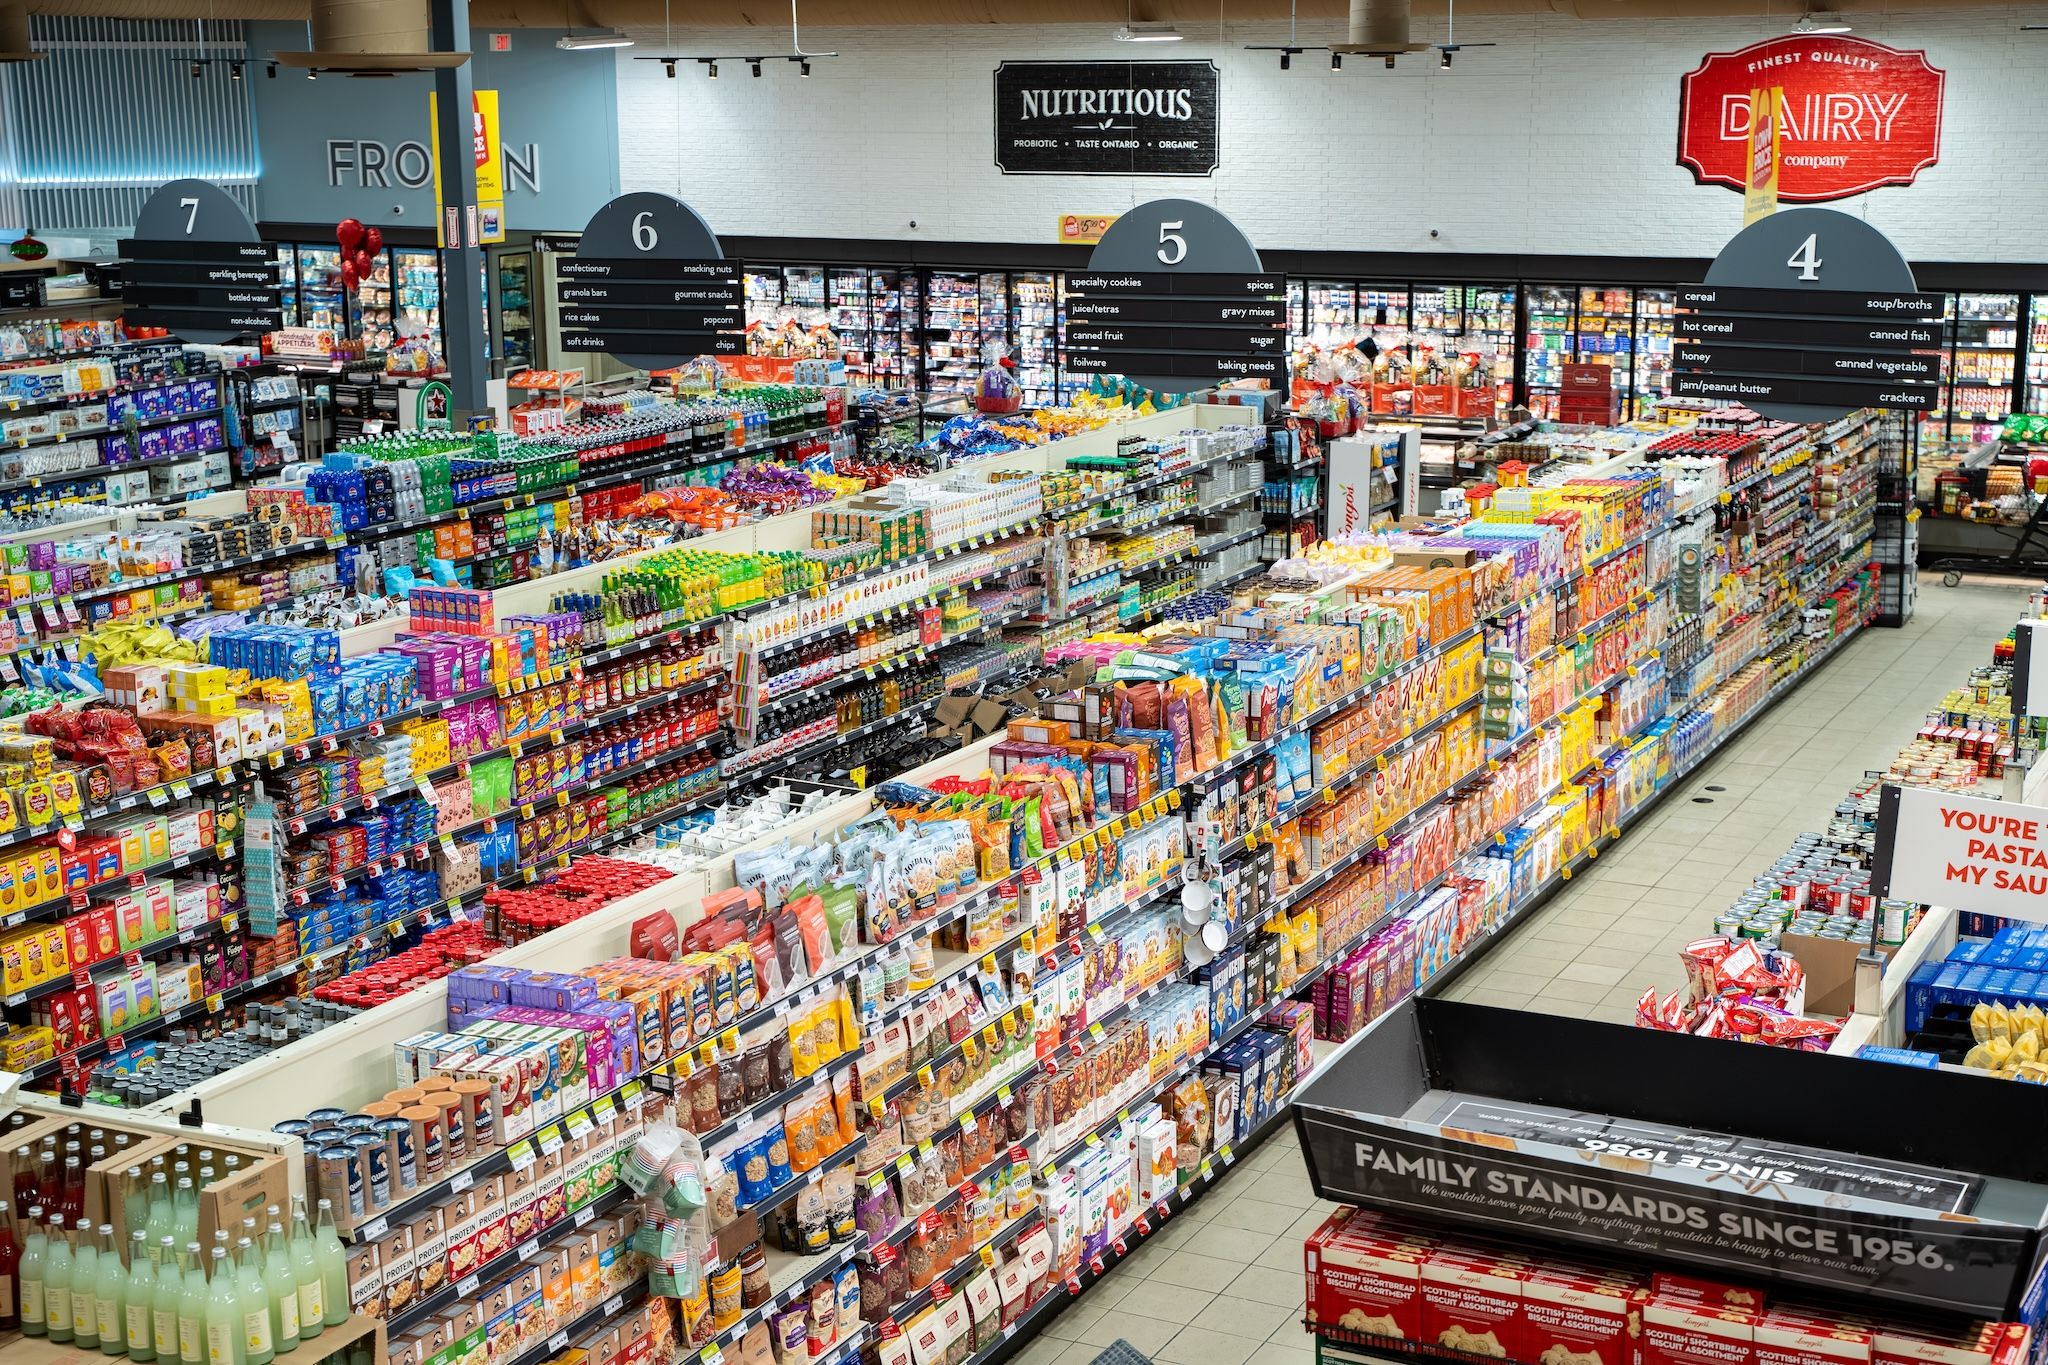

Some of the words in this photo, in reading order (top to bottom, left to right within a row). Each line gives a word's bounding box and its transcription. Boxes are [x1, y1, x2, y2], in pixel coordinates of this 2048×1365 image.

[1748, 52, 1802, 74] FINEST
[1811, 51, 1880, 72] QUALITY
[1020, 88, 1192, 121] NUTRITIOUS
[1720, 93, 1908, 142] DAIRY
[1014, 139, 1058, 148] PROBIOTIC
[1075, 140, 1100, 148] TASTE
[1102, 140, 1140, 149] ONTARIO
[1159, 140, 1199, 149] ORGANIC
[327, 139, 540, 193] FRON
[1784, 154, 1848, 169] company
[180, 198, 199, 234] 7
[632, 211, 658, 251] 6
[1157, 220, 1187, 265] 5
[240, 247, 266, 256] isotonics
[1787, 233, 1823, 281] 4
[209, 270, 236, 281] sparkling
[237, 270, 268, 281] beverages
[562, 264, 611, 275] confectionary
[683, 264, 715, 276] snacking
[717, 265, 733, 273] nuts
[1071, 277, 1108, 288] specialty
[1110, 277, 1142, 287] cookies
[1247, 280, 1274, 291] spices
[228, 293, 250, 302] bottled
[252, 294, 269, 302] water
[564, 289, 590, 299] granola
[591, 289, 607, 297] bars
[675, 291, 706, 301] gourmet
[708, 291, 733, 299] snacks
[1684, 291, 1716, 302] cereal
[1072, 303, 1120, 315] juice/tetras
[1867, 299, 1932, 311] soup/broths
[580, 314, 600, 322] cakes
[1222, 307, 1247, 319] gravy
[1249, 306, 1275, 316] mixes
[231, 317, 272, 326] non-alcoholic
[703, 317, 734, 326] popcorn
[1682, 321, 1700, 331] hot
[1702, 322, 1733, 333] cereal
[1072, 331, 1103, 341] canned
[1104, 331, 1124, 341] fruit
[1250, 336, 1275, 347] sugar
[1869, 330, 1908, 340] canned
[1910, 331, 1931, 341] fish
[277, 339, 315, 349] APPETIZERS
[567, 338, 581, 346] soft
[582, 338, 604, 347] drinks
[716, 341, 735, 350] chips
[1073, 357, 1107, 368] foilware
[1681, 351, 1711, 364] honey
[1217, 360, 1247, 373] baking
[1249, 361, 1275, 371] needs
[1835, 358, 1873, 370] canned
[1875, 361, 1928, 374] vegetable
[1679, 380, 1737, 394] jam/peanut
[1740, 382, 1772, 395] butter
[1879, 392, 1926, 403] crackers
[430, 722, 448, 735] MADE
[455, 780, 472, 793] MADE
[218, 800, 236, 812] Lemon
[1940, 808, 2038, 841] YOU'RE
[461, 845, 480, 857] MADE
[1967, 839, 2048, 869] PASTA
[1257, 852, 1271, 864] TRUE
[1240, 863, 1255, 875] TRUE
[1945, 863, 1988, 885] MY
[219, 872, 238, 885] Coconut
[227, 945, 243, 956] Fudge
[204, 953, 220, 964] Fudge
[1577, 1137, 1675, 1163] 1956.
[1677, 1153, 1799, 1184] SINCE
[539, 1174, 563, 1194] PROTEIN
[509, 1190, 535, 1210] PROTEIN
[1354, 1142, 1478, 1190] FAMILY
[1487, 1170, 1709, 1229] STANDARDS
[1719, 1213, 1838, 1254] SINCE
[1846, 1234, 1955, 1272] 1956.
[479, 1206, 505, 1227] PROTEIN
[449, 1222, 476, 1244] PROTEIN
[1421, 1184, 1439, 1196] We
[1488, 1196, 1517, 1210] serve
[1518, 1201, 1547, 1215] your
[1547, 1207, 1588, 1226] family
[1591, 1215, 1642, 1235] anything
[1644, 1224, 1662, 1233] we
[1714, 1236, 1729, 1248] be
[1731, 1240, 1770, 1260] happy
[1773, 1248, 1785, 1258] to
[1789, 1252, 1821, 1265] serve
[1823, 1258, 1847, 1269] our
[418, 1240, 445, 1262] PROTEIN
[386, 1259, 413, 1280] PROTEIN
[1322, 1268, 1361, 1284] SCOTTISH
[1361, 1276, 1416, 1293] SHORTBREAD
[1327, 1277, 1356, 1290] BISCUIT
[1358, 1284, 1412, 1301] ASSORTMENT
[1422, 1285, 1462, 1300] SCOTTISH
[1462, 1293, 1518, 1309] SHORTBREAD
[1426, 1293, 1456, 1306] BISCUIT
[1458, 1300, 1514, 1317] ASSORTMENT
[1523, 1303, 1565, 1318] SCOTTISH
[1566, 1311, 1624, 1328] SHORTBREAD
[1527, 1312, 1560, 1325] BISCUIT
[1561, 1319, 1620, 1336] ASSORTMENT
[1645, 1329, 1688, 1344] SCOTTISH
[1689, 1337, 1749, 1355] SHORTBREAD
[1650, 1338, 1683, 1351] BISCUIT
[1684, 1345, 1745, 1362] ASSORTMENT
